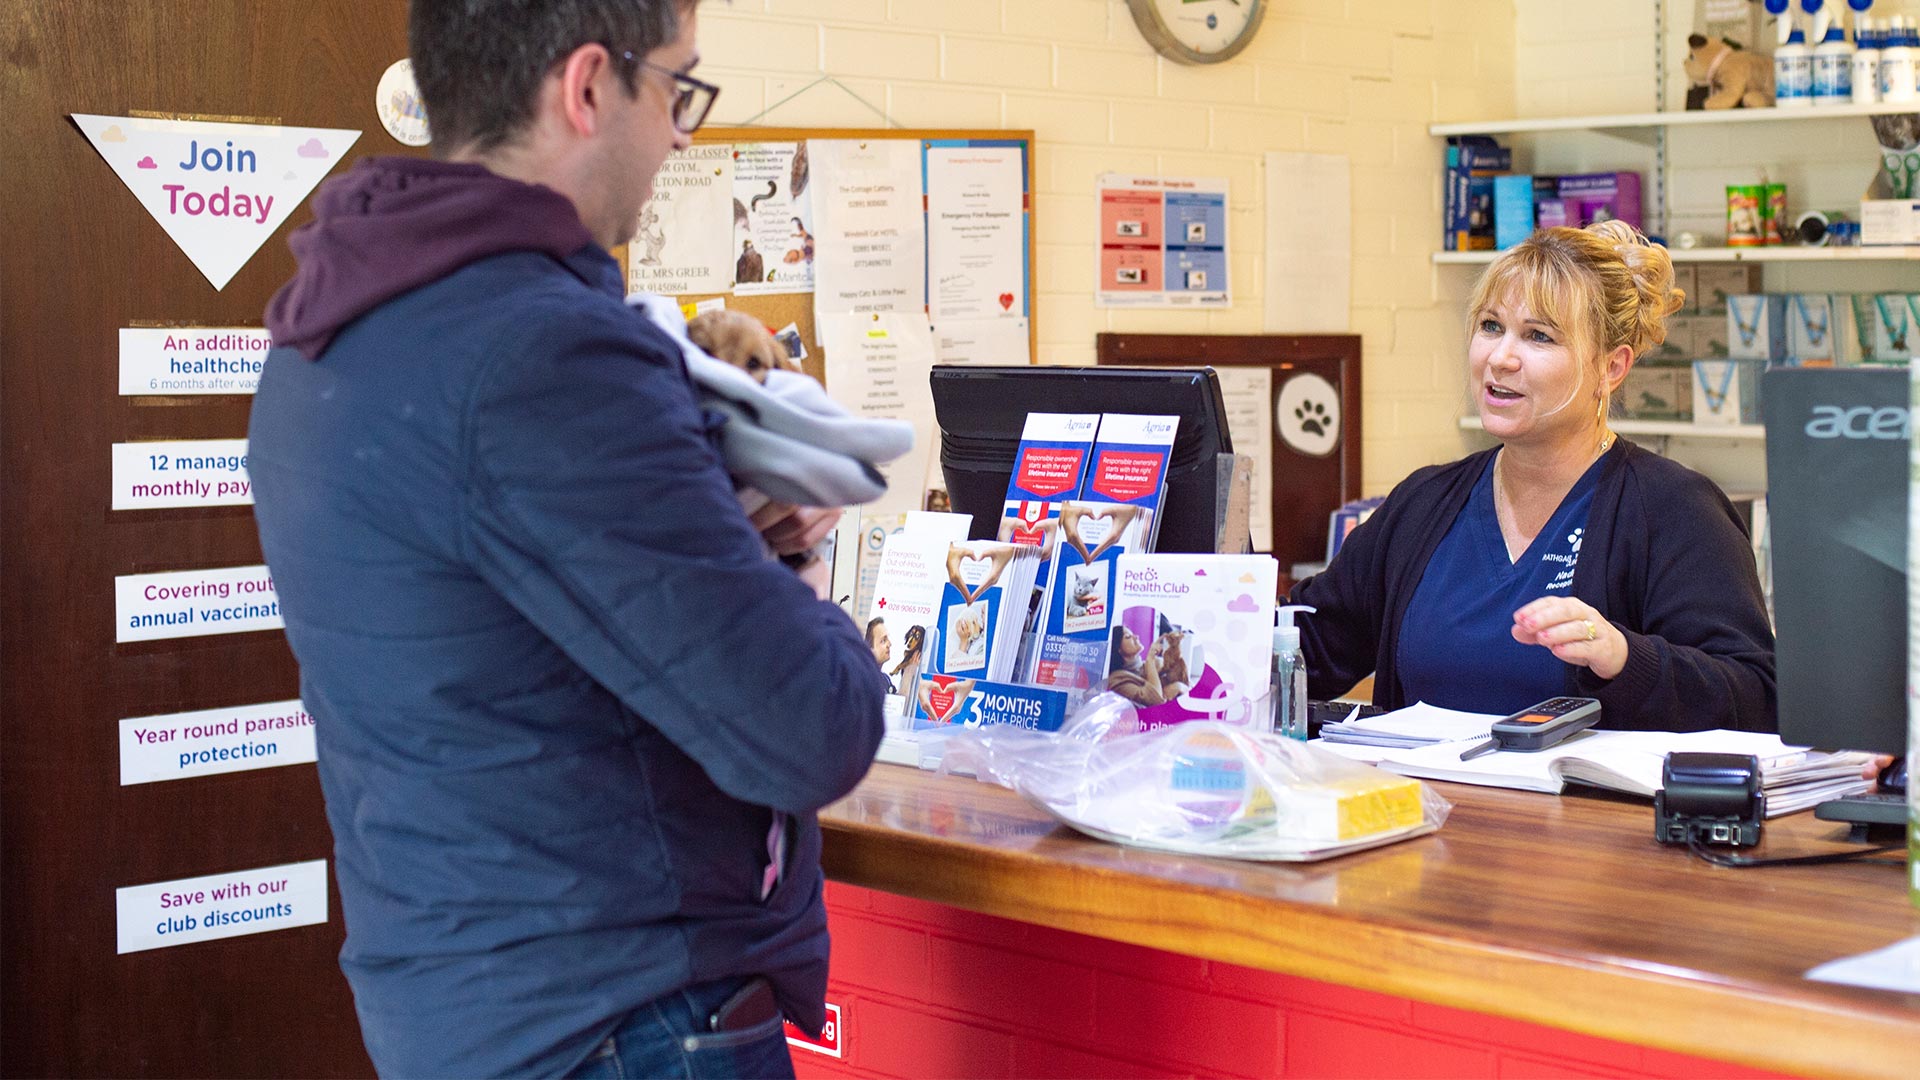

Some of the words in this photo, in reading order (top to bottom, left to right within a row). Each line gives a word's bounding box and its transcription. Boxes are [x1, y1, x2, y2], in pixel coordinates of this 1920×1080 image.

[179, 140, 256, 173] Join
[688, 148, 729, 159] CLASSES
[684, 178, 712, 187] ROAD
[162, 184, 274, 224] Today
[653, 269, 675, 278] MRS
[676, 267, 710, 278] GREER
[163, 336, 194, 351] An
[149, 379, 158, 389] 6
[161, 378, 205, 389] months
[208, 378, 234, 389] after
[149, 455, 169, 471] 12
[1103, 457, 1132, 466] Responsible
[132, 479, 211, 498] monthly
[1124, 569, 1144, 581] Pet
[144, 581, 230, 601] Covering
[1123, 581, 1162, 593] Health
[1163, 582, 1190, 593] Club
[130, 607, 194, 628] annual
[964, 690, 986, 730] 3
[984, 693, 1043, 718] MONTHS
[134, 728, 177, 745] Year
[184, 719, 238, 740] round
[245, 711, 316, 736] parasite
[1009, 713, 1040, 731] PRICE
[179, 741, 278, 768] protection
[160, 892, 205, 908] Save
[211, 882, 251, 901] with
[257, 879, 288, 895] our
[156, 914, 197, 934] club
[203, 902, 292, 928] discounts
